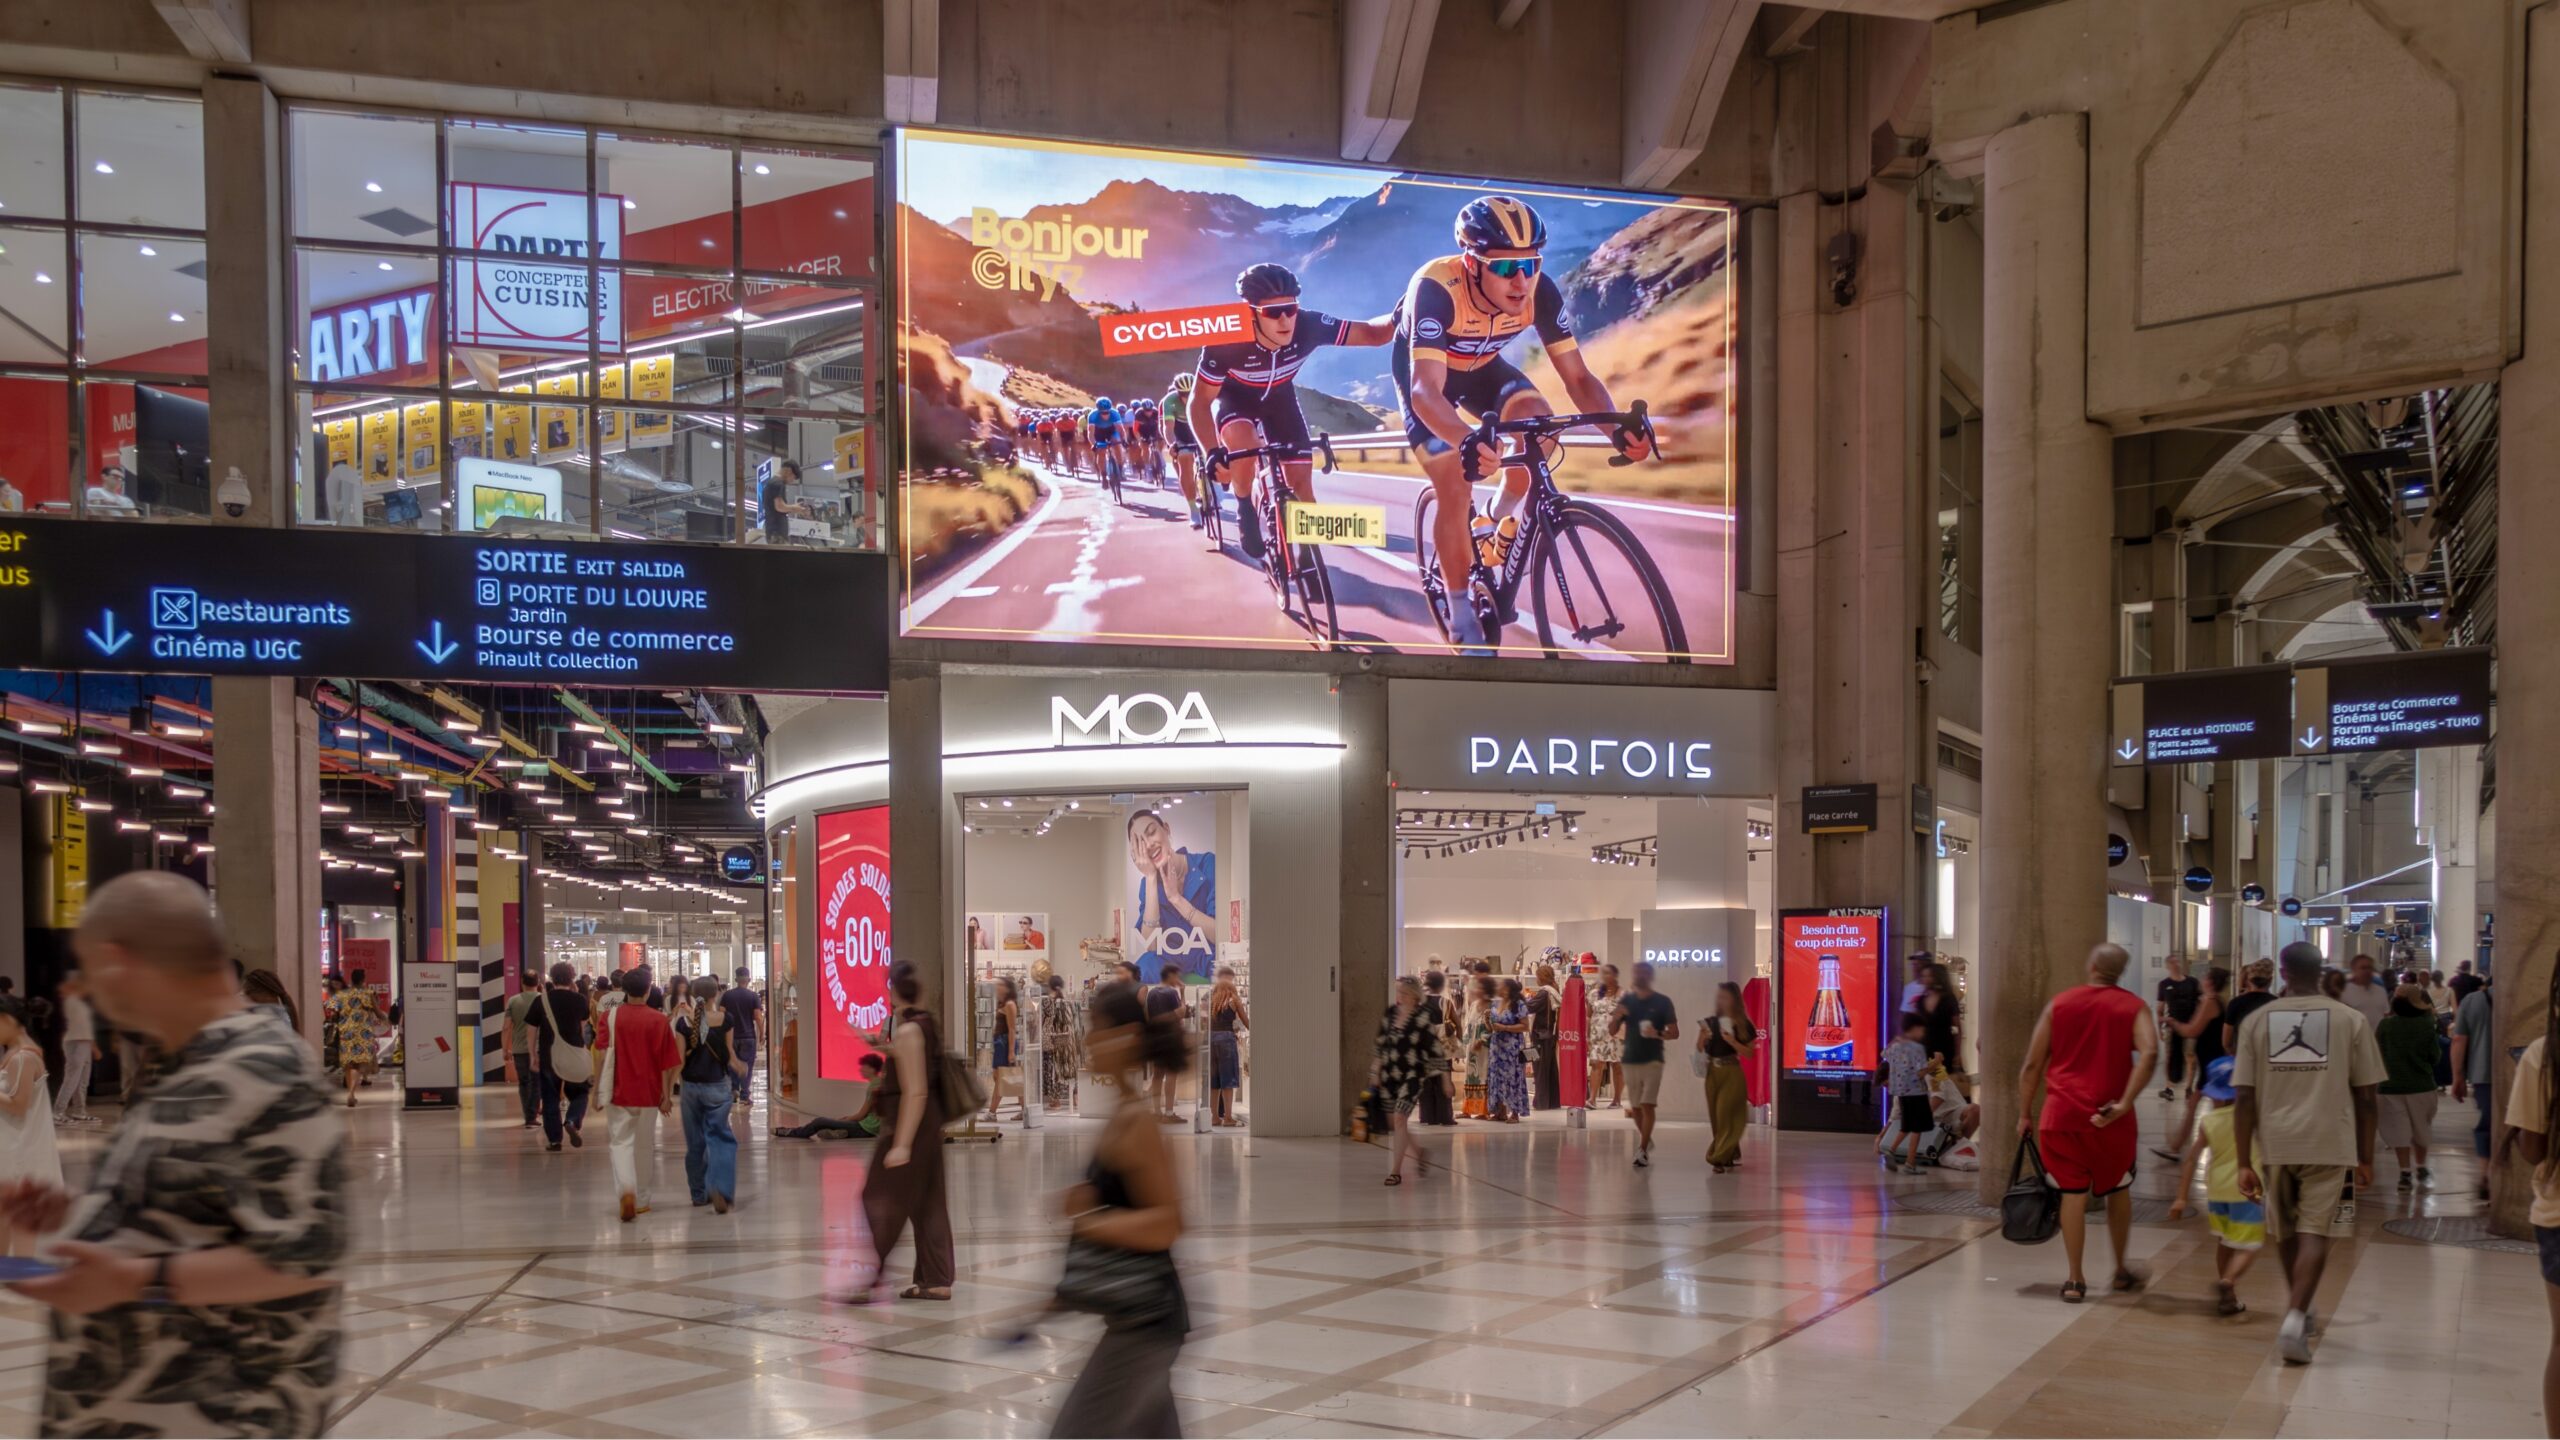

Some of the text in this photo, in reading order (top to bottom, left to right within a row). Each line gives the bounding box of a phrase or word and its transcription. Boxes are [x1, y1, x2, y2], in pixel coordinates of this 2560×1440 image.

[971, 206, 1149, 262] Bonjour
[1113, 314, 1242, 344] CYCLISME
[477, 551, 685, 578] SORTIE EXIT SALIDA
[509, 585, 578, 605] PORTE
[586, 587, 615, 606] DU
[624, 590, 708, 608] LOUVRE
[200, 600, 350, 625] Restaurants
[510, 608, 568, 624] Jardin
[154, 635, 303, 660] Cinéma UGC
[478, 626, 734, 651] Bourse de commerce
[478, 651, 639, 670] Pinault Collection
[2333, 696, 2458, 714] Bourse de Commerce
[1052, 691, 1226, 746] MOA
[2333, 711, 2405, 725] Cinéma UGC
[2333, 726, 2372, 736] Forum
[2391, 719, 2437, 732] Images
[2148, 727, 2180, 739] PLACE
[2205, 721, 2255, 734] ROTONDE
[2333, 735, 2377, 746] Piscine
[1471, 736, 1712, 779] PARFOIS
[1808, 813, 1830, 821] Place
[825, 867, 857, 931] SOLDES
[1801, 925, 1836, 935] Besoin
[1131, 927, 1213, 956] MOA
[1795, 938, 1820, 949] coup
[1821, 937, 1835, 947] de
[1836, 937, 1859, 948] frais
[1645, 949, 1721, 962] PARFOIS
[823, 938, 847, 1013] SOLDES
[2270, 1064, 2328, 1073] JORDAN
[1090, 1073, 1118, 1087] MO
